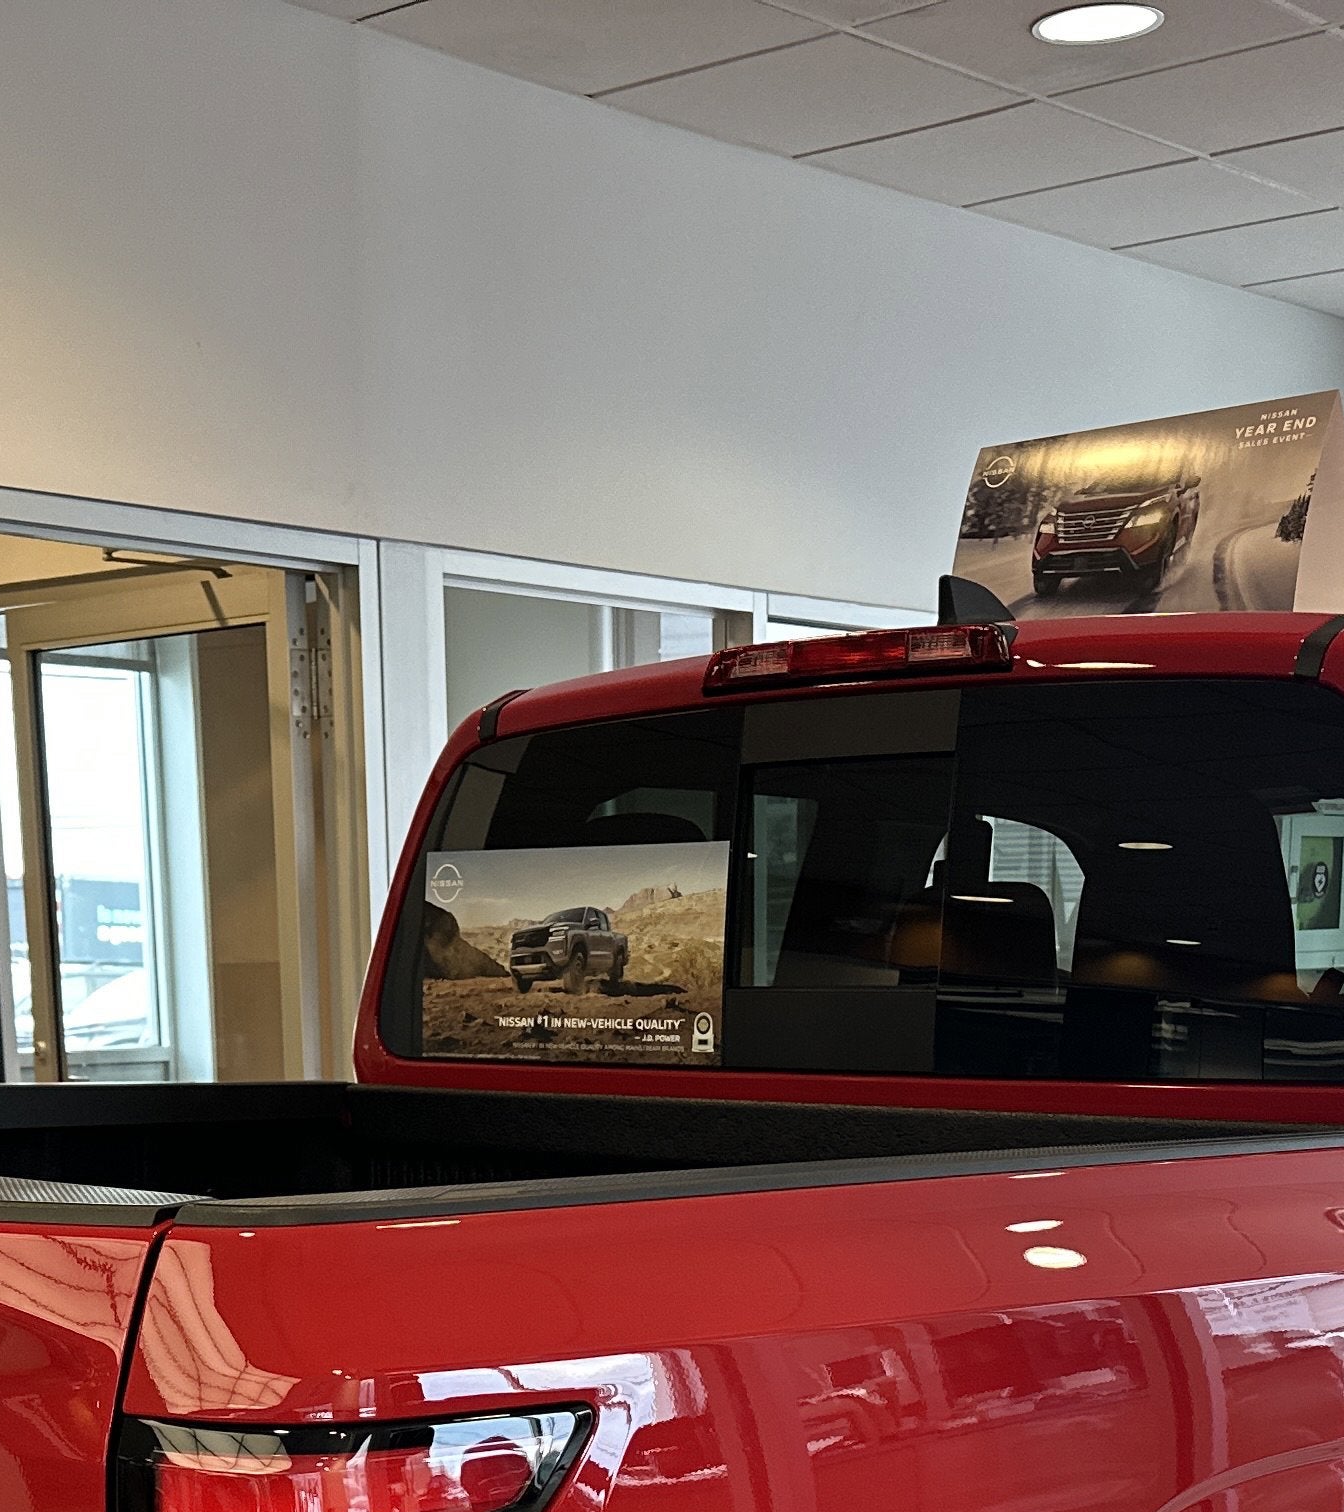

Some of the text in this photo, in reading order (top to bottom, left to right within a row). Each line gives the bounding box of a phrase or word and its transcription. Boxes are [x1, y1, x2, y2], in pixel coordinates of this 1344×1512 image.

[1260, 408, 1298, 421] NISSAN
[1235, 416, 1317, 440] YEAR END
[1238, 438, 1269, 450] SALES
[537, 1014, 549, 1028] #1
[551, 1017, 562, 1028] IN
[563, 1018, 634, 1030] NEW-VEHICLE
[655, 1034, 681, 1043] POWER
